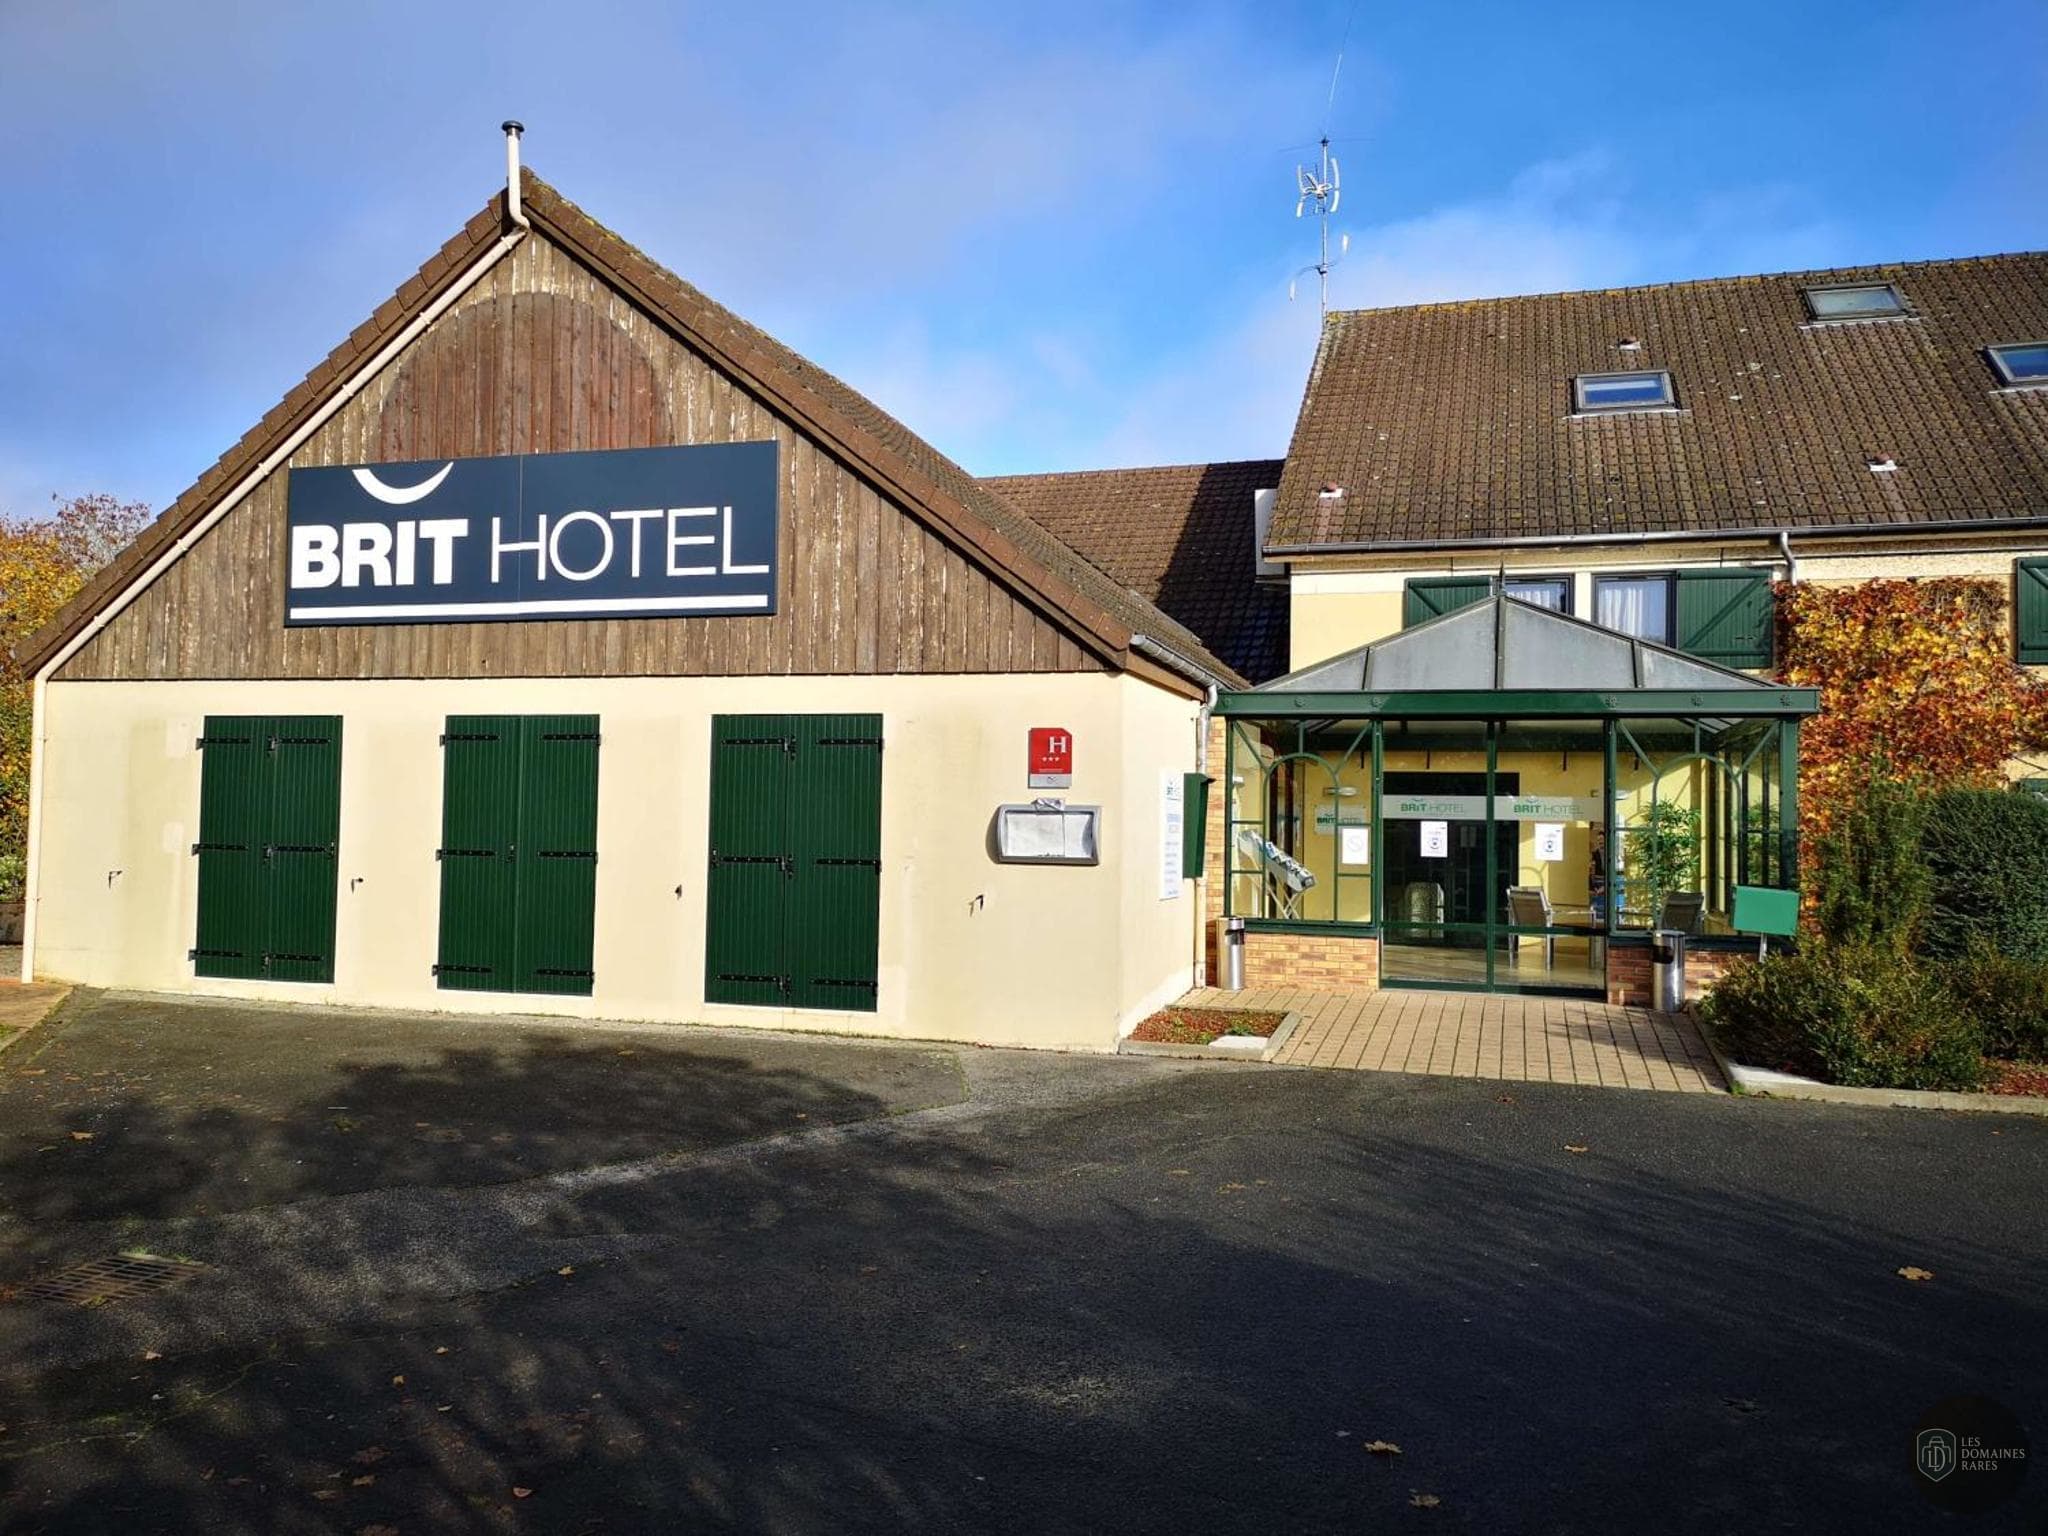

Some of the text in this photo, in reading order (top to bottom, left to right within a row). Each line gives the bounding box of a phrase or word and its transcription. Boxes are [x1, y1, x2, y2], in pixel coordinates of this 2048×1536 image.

[290, 506, 770, 589] BRIT HOTEL
[1049, 736, 1067, 753] H
[1400, 803, 1428, 812] BRIT
[1513, 804, 1541, 814] BRIT
